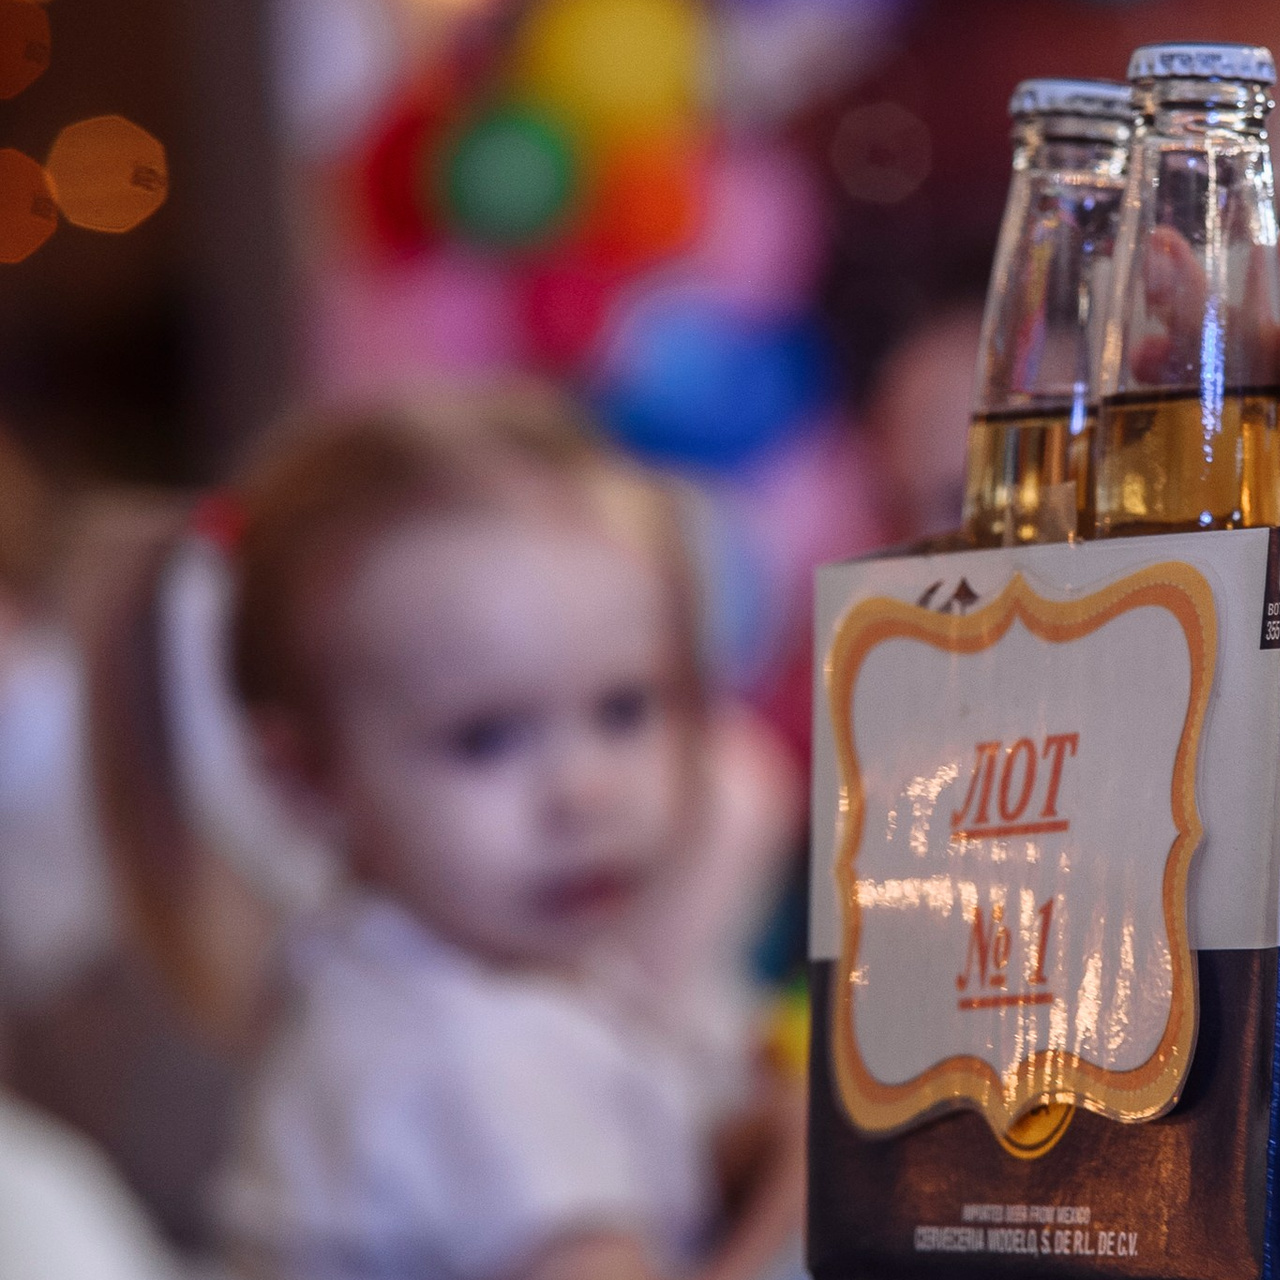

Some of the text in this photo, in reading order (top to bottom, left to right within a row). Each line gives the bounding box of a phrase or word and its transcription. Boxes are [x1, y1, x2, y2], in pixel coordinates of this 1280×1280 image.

[951, 731, 1080, 827] ЛОТ
[1054, 1229, 1071, 1255] DE
[1097, 1230, 1115, 1256] DE
